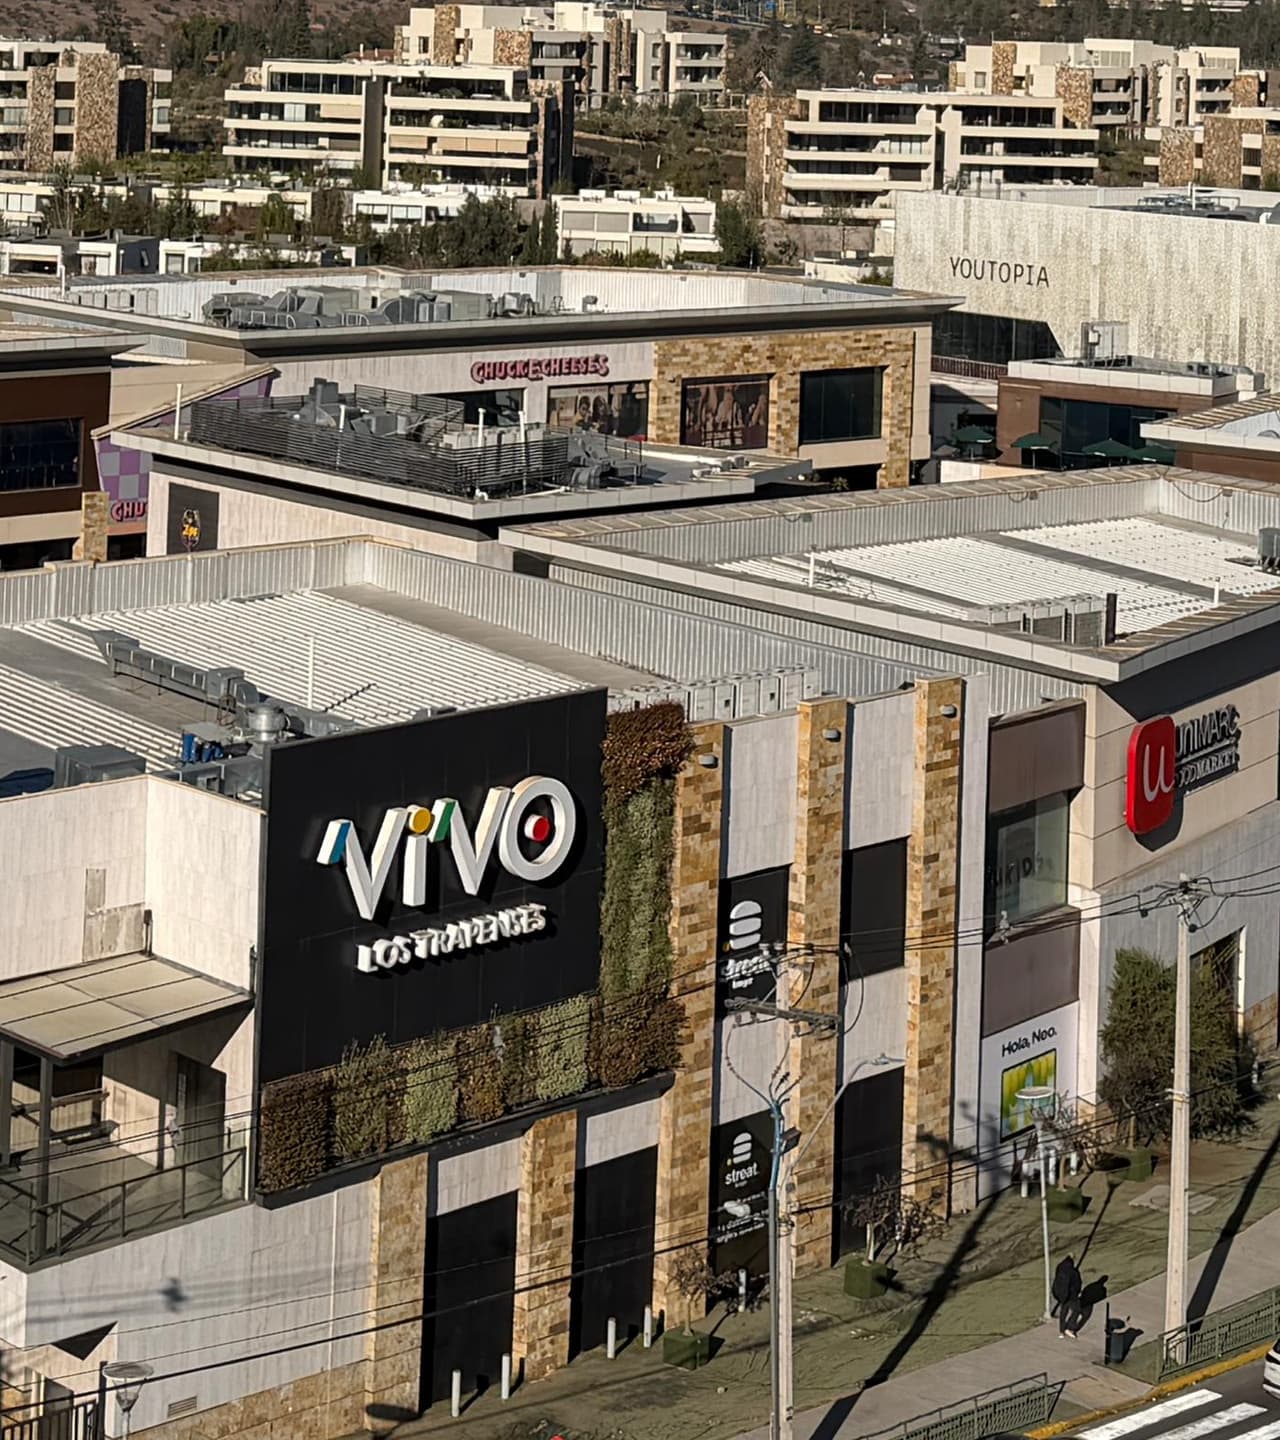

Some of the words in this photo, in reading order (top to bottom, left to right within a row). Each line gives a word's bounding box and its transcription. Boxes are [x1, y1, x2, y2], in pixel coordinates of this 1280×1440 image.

[949, 256, 1050, 289] YOUTOPIA
[356, 933, 413, 973] LOS
[409, 903, 547, 960] TRAPENSES
[1001, 1037, 1031, 1058] Hola,
[1031, 1026, 1058, 1045] Neo.
[725, 1161, 759, 1186] streat
